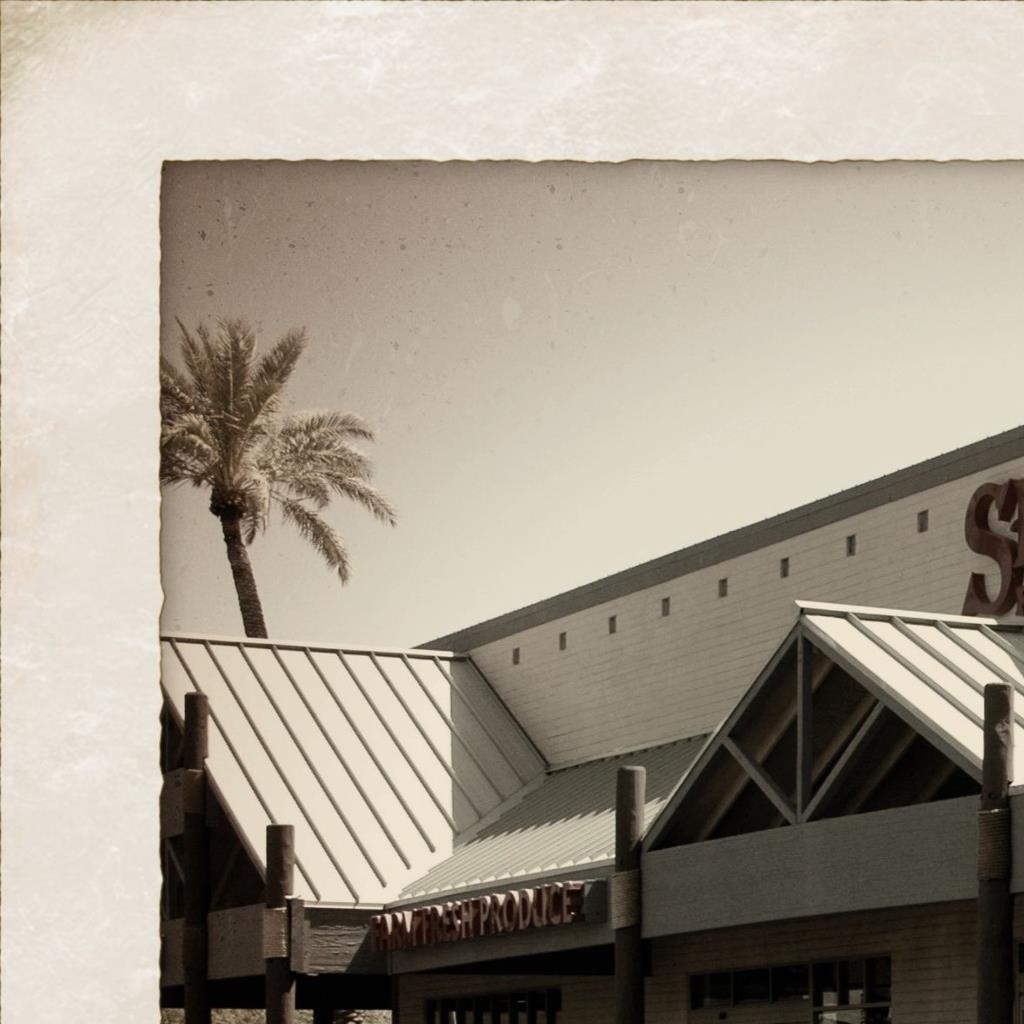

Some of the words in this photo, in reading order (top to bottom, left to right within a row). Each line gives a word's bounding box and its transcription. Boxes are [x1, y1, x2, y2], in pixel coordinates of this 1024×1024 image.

[371, 910, 422, 952] FARM
[421, 897, 480, 945] FRESH
[479, 880, 585, 936] PRODUCE
